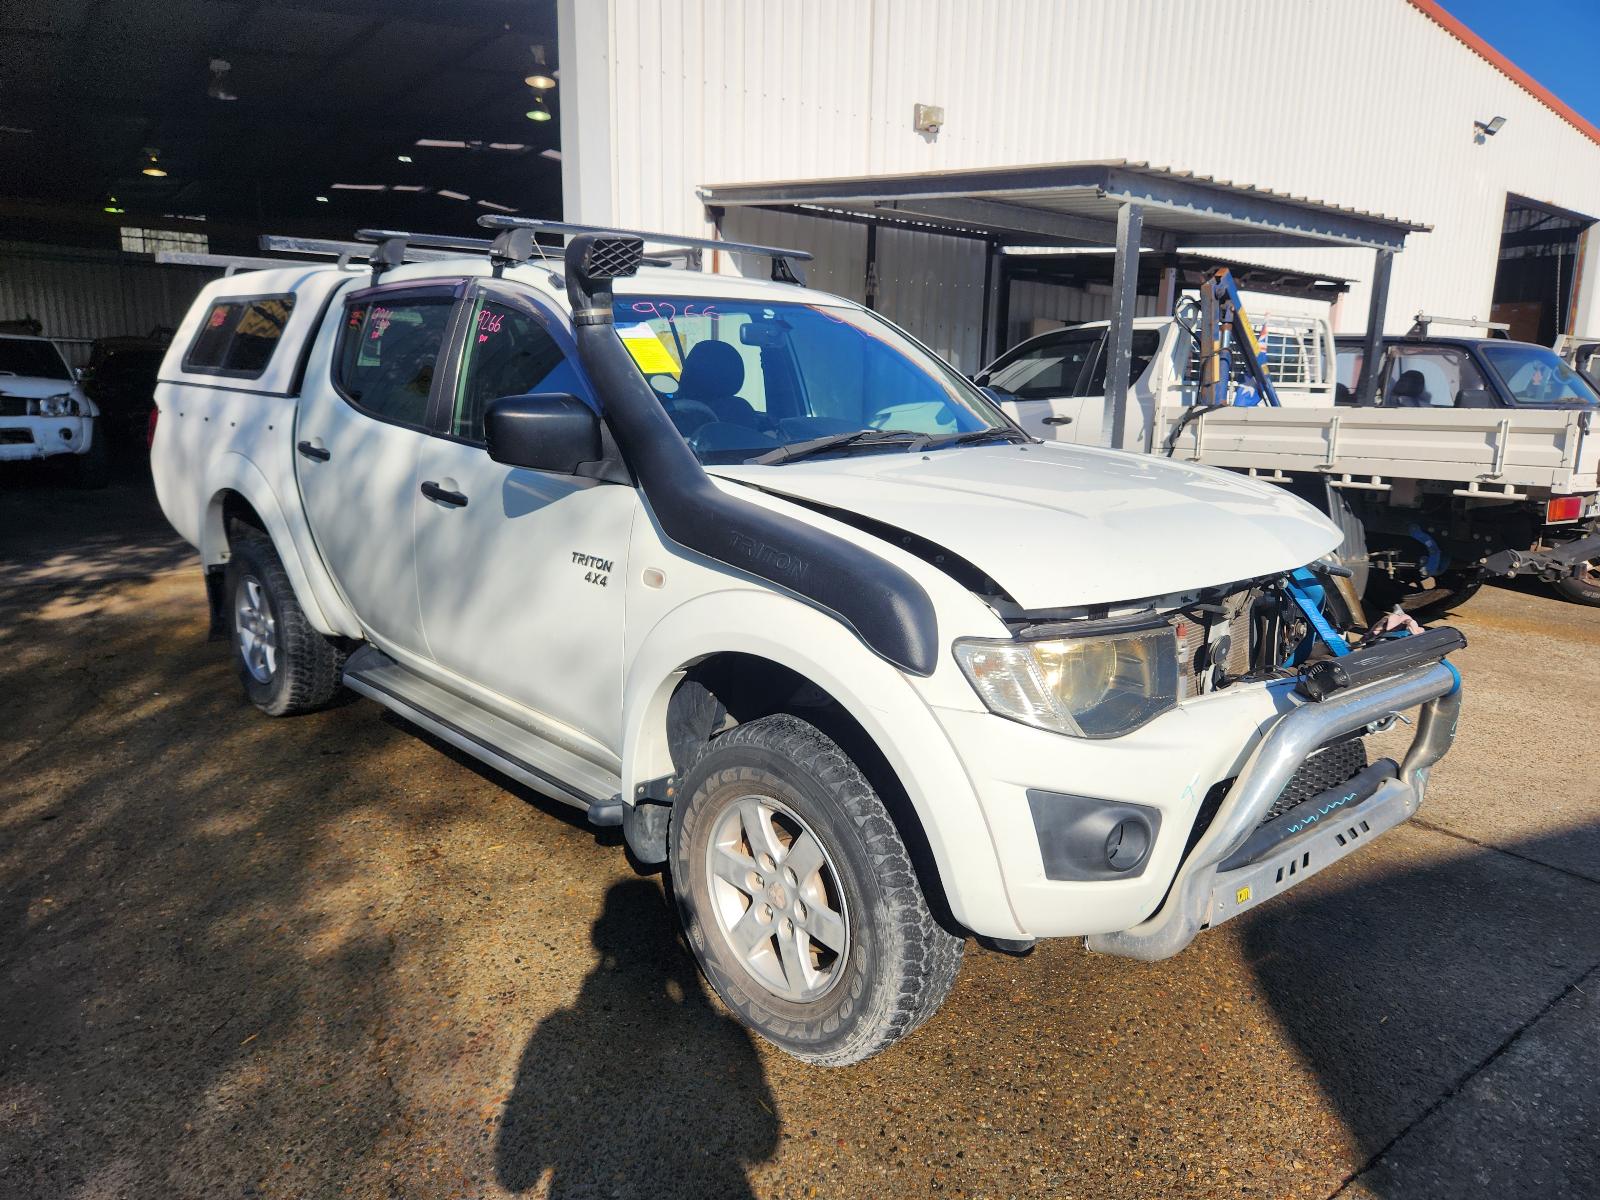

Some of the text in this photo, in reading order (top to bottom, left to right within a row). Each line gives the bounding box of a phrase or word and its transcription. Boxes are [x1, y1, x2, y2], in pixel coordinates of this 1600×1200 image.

[478, 310, 504, 332] 9266
[632, 302, 720, 323] 9266
[572, 551, 613, 573] TRITON
[730, 530, 809, 577] TRITON
[584, 571, 608, 587] 4X4
